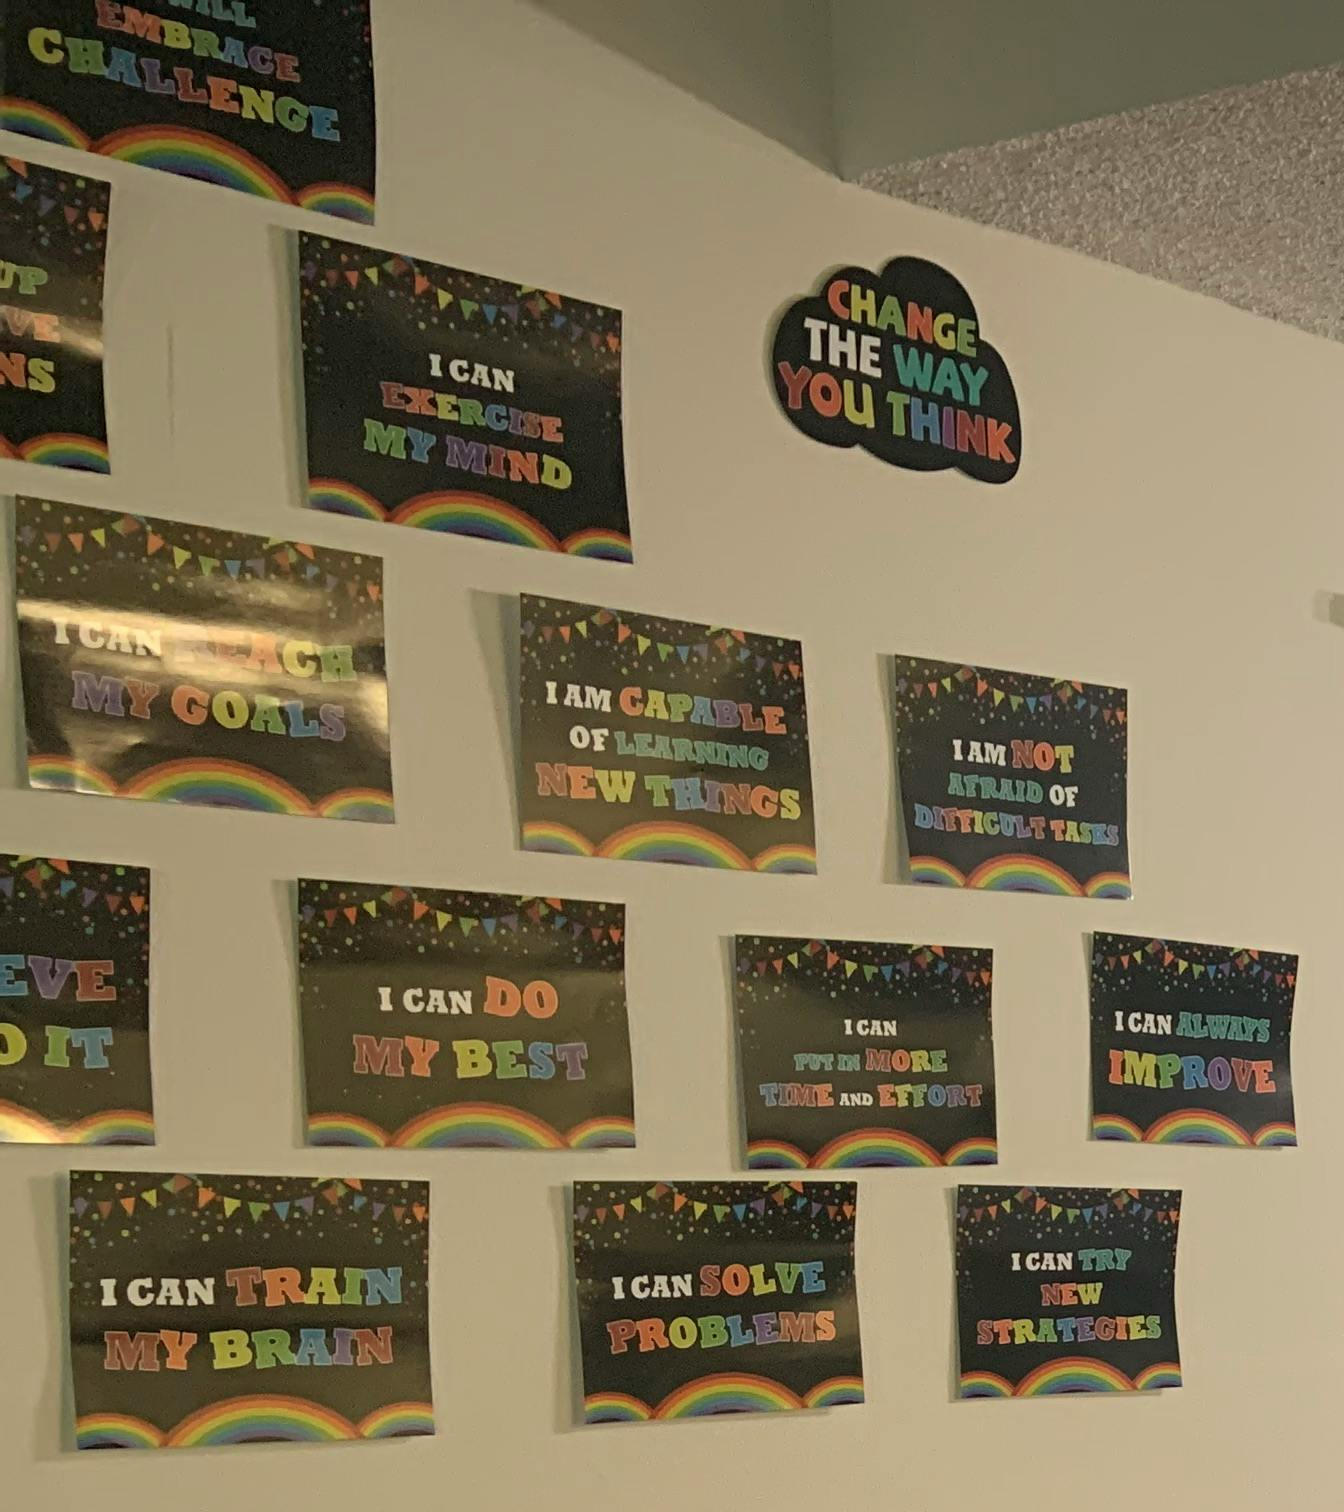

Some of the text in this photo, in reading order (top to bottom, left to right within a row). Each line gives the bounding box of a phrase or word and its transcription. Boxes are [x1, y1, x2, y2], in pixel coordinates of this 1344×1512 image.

[96, 0, 300, 82] EMBRACE
[27, 27, 340, 141] CHALLENGE
[827, 280, 977, 358] CHANGE
[428, 353, 515, 393] I CAN
[803, 317, 989, 406] THE WAY
[379, 380, 565, 443] EXERCISE
[777, 360, 1016, 464] YOU THINK
[363, 417, 573, 490] MY MIND
[51, 618, 70, 645] I
[78, 620, 162, 657] CAN
[71, 670, 347, 742] MY GOALS
[545, 681, 788, 735] I AM CAPABLE
[569, 725, 770, 771] OF LEARNING
[952, 739, 1075, 774] I AM NOT
[535, 762, 802, 821] NEW THINGS
[947, 772, 1079, 808] AFRAID OF
[913, 802, 1120, 847] DIFFICULT TASKS
[377, 975, 559, 1019] I CAN DO
[43, 1024, 114, 1069] IT
[844, 1018, 897, 1037] I CAN
[1114, 1010, 1271, 1044] I CAN ALWAYS
[352, 1034, 589, 1081] MY BEST
[793, 1048, 948, 1073] PUT IN MORE
[1108, 1048, 1277, 1094] IMPROVE
[759, 1082, 983, 1109] TIME AND EFFORT
[611, 1260, 826, 1300] I CAN SOLVE
[1011, 1248, 1133, 1272] I CAN TRY
[100, 1266, 403, 1307] I CAN TRAIN
[1040, 1281, 1103, 1307] NEW
[103, 1325, 394, 1372] MY BRAIN
[605, 1310, 836, 1355] PROBLEMS
[976, 1315, 1162, 1346] STRATEGIES
